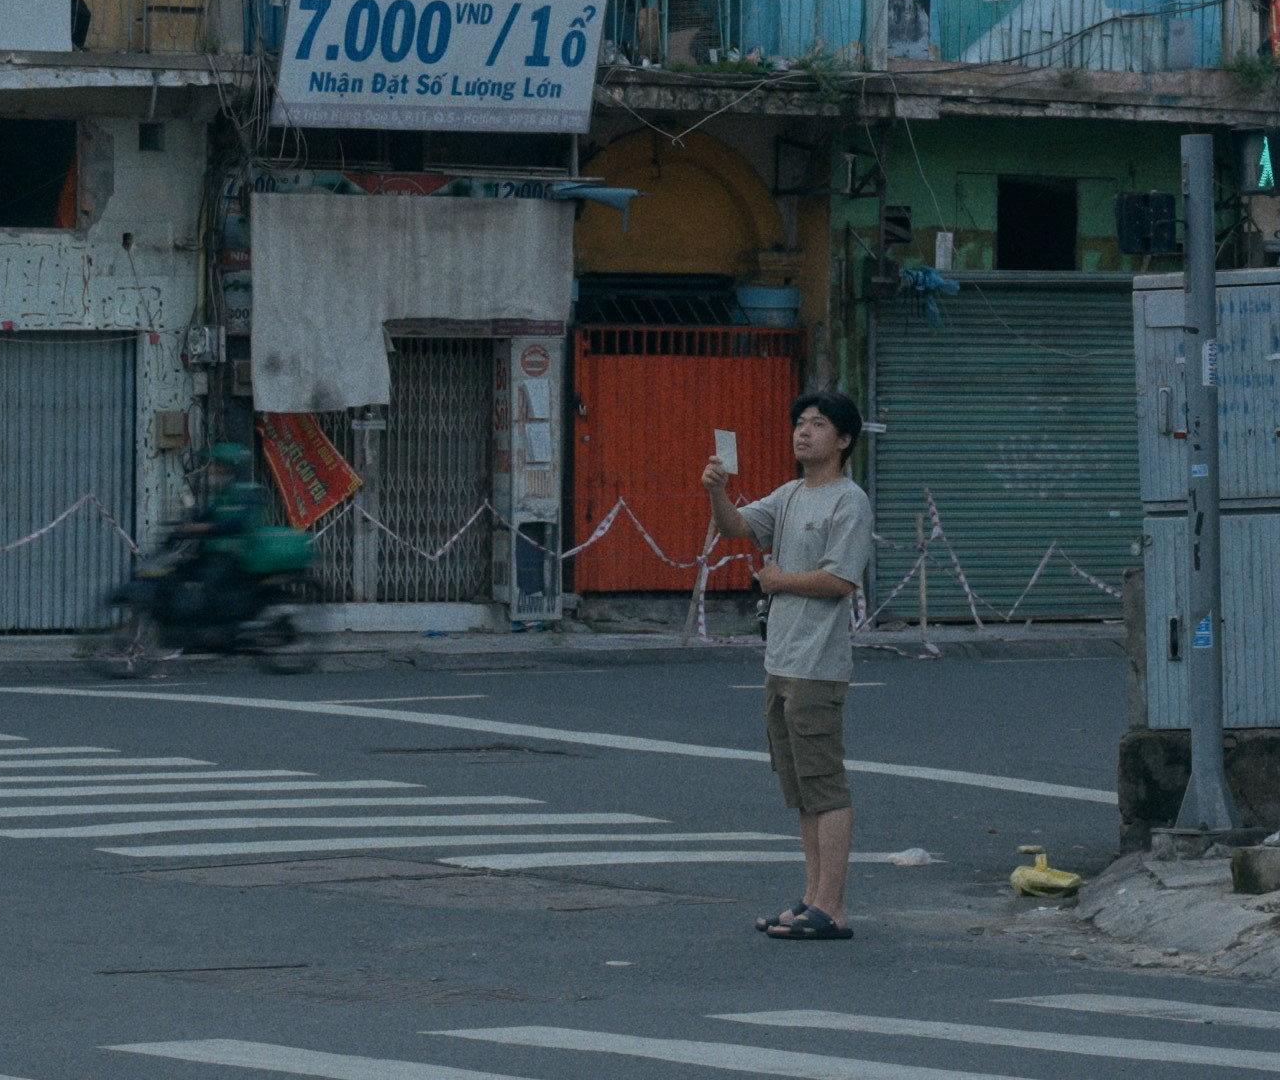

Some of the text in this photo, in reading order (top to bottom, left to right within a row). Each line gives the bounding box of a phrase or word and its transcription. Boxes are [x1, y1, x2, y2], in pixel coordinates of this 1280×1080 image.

[455, 2, 494, 25] VND
[561, 5, 596, 68] ổ
[309, 72, 563, 101] Nhận Đặt Số Lượng Lớn
